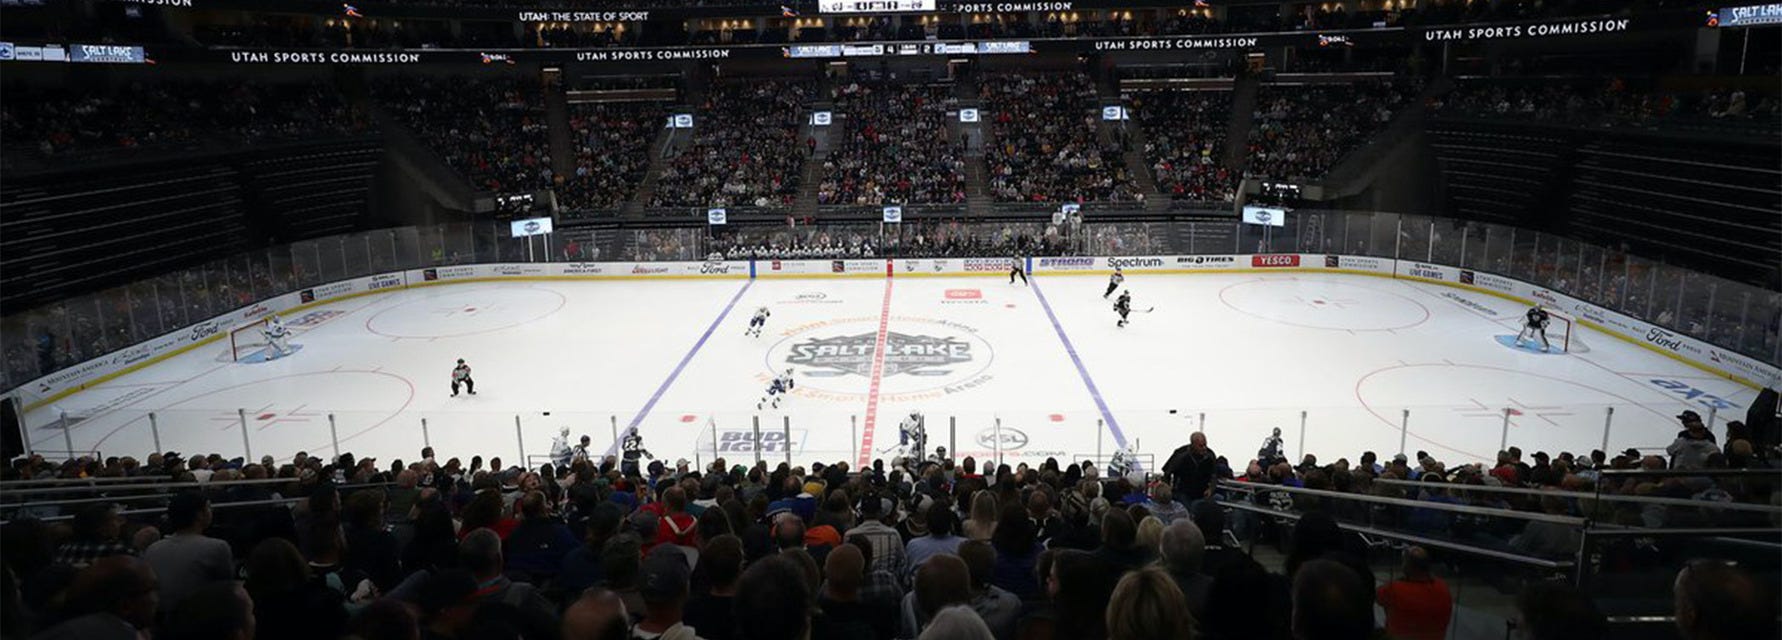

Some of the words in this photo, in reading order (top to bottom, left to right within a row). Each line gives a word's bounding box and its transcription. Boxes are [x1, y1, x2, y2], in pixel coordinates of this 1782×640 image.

[997, 2, 1072, 12] COMMISSION
[1731, 6, 1760, 23] SALT
[1761, 3, 1782, 16] LAK
[552, 12, 571, 21] THE
[573, 12, 600, 21] STATE
[603, 12, 616, 21] OF
[618, 12, 649, 21] SPORT
[1425, 29, 1462, 41] UTAH
[1468, 26, 1521, 39] SPORTS
[1527, 19, 1629, 37] COMMISSION
[1095, 41, 1125, 50] UTAH
[1129, 40, 1172, 50] SPORTS
[1175, 37, 1257, 49] COMMISSION
[82, 45, 106, 60] SALT
[107, 46, 133, 60] LAKE
[231, 52, 269, 62] UTAH
[274, 52, 325, 63] SPORTS
[330, 53, 419, 63] COMMISSION
[577, 52, 606, 61] UTAH
[611, 51, 653, 60] SPORTS
[656, 49, 729, 60] COMMISSION
[700, 260, 730, 274] Ford
[1107, 257, 1161, 269] Spectrum
[1260, 256, 1292, 265] YESCO
[191, 321, 218, 341] Ford
[1646, 327, 1681, 351] Ford
[793, 344, 874, 361] SALT
[885, 343, 969, 359] LAKE
[720, 431, 786, 442] BUD
